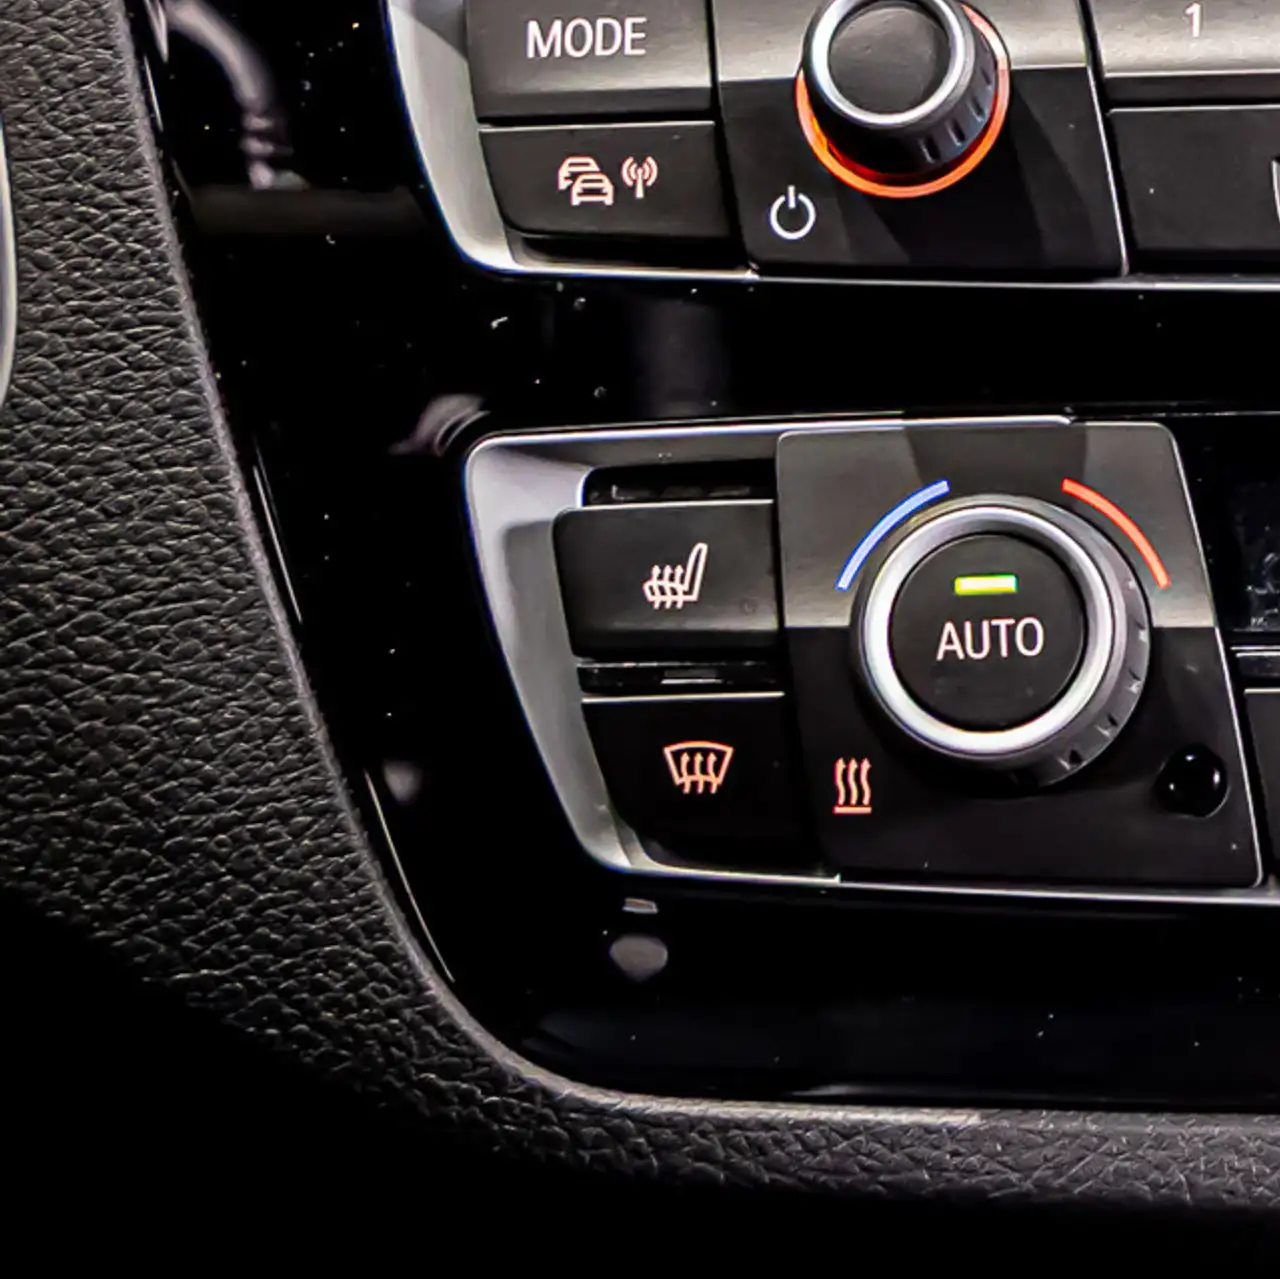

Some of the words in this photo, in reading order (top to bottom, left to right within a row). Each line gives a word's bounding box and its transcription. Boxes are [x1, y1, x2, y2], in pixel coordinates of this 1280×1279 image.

[527, 17, 647, 58] MODE
[1184, 3, 1203, 37] 1
[937, 617, 1043, 660] AUTO
